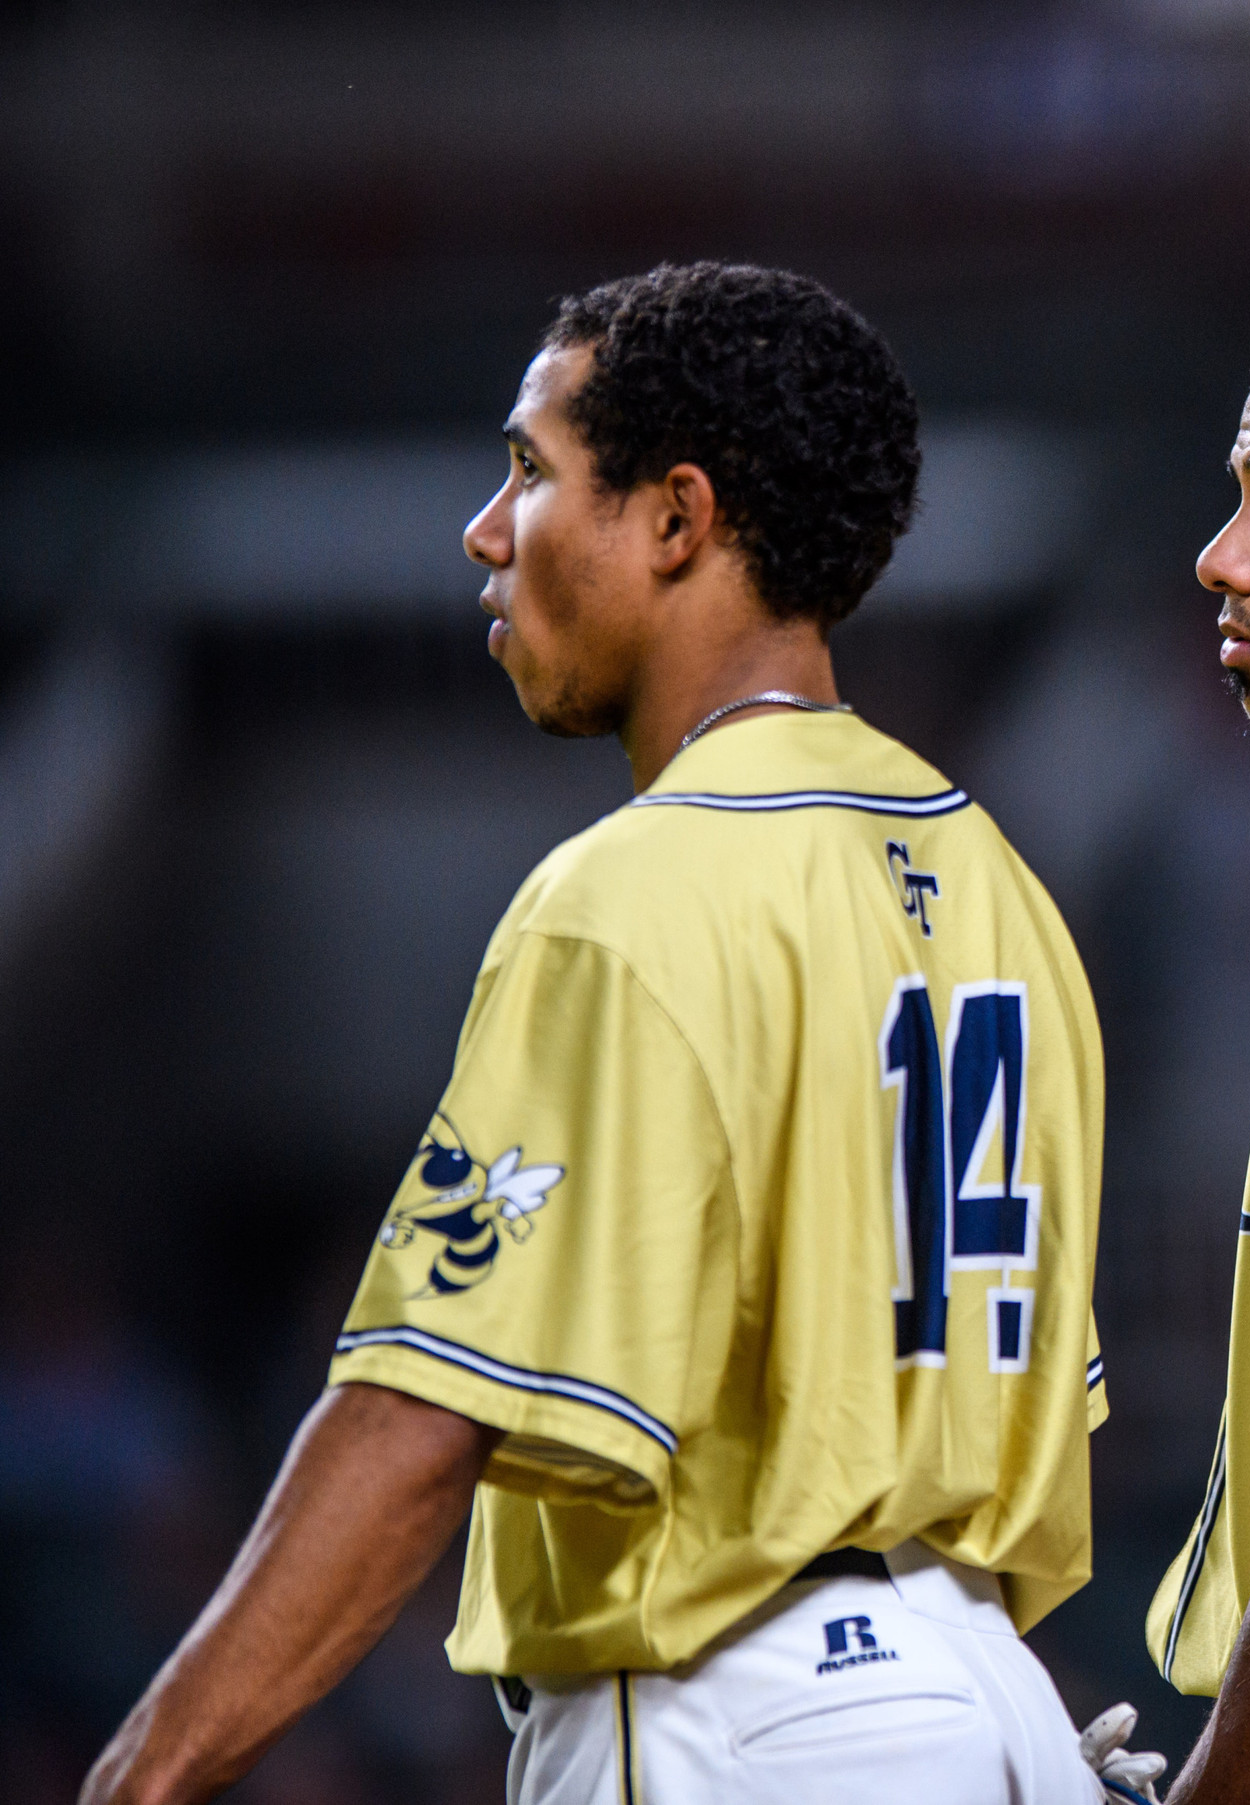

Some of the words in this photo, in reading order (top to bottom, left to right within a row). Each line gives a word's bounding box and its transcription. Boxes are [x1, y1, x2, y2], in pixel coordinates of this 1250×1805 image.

[877, 971, 1042, 1374] 14
[823, 1615, 877, 1654] R
[815, 1650, 901, 1676] RUSSELL
